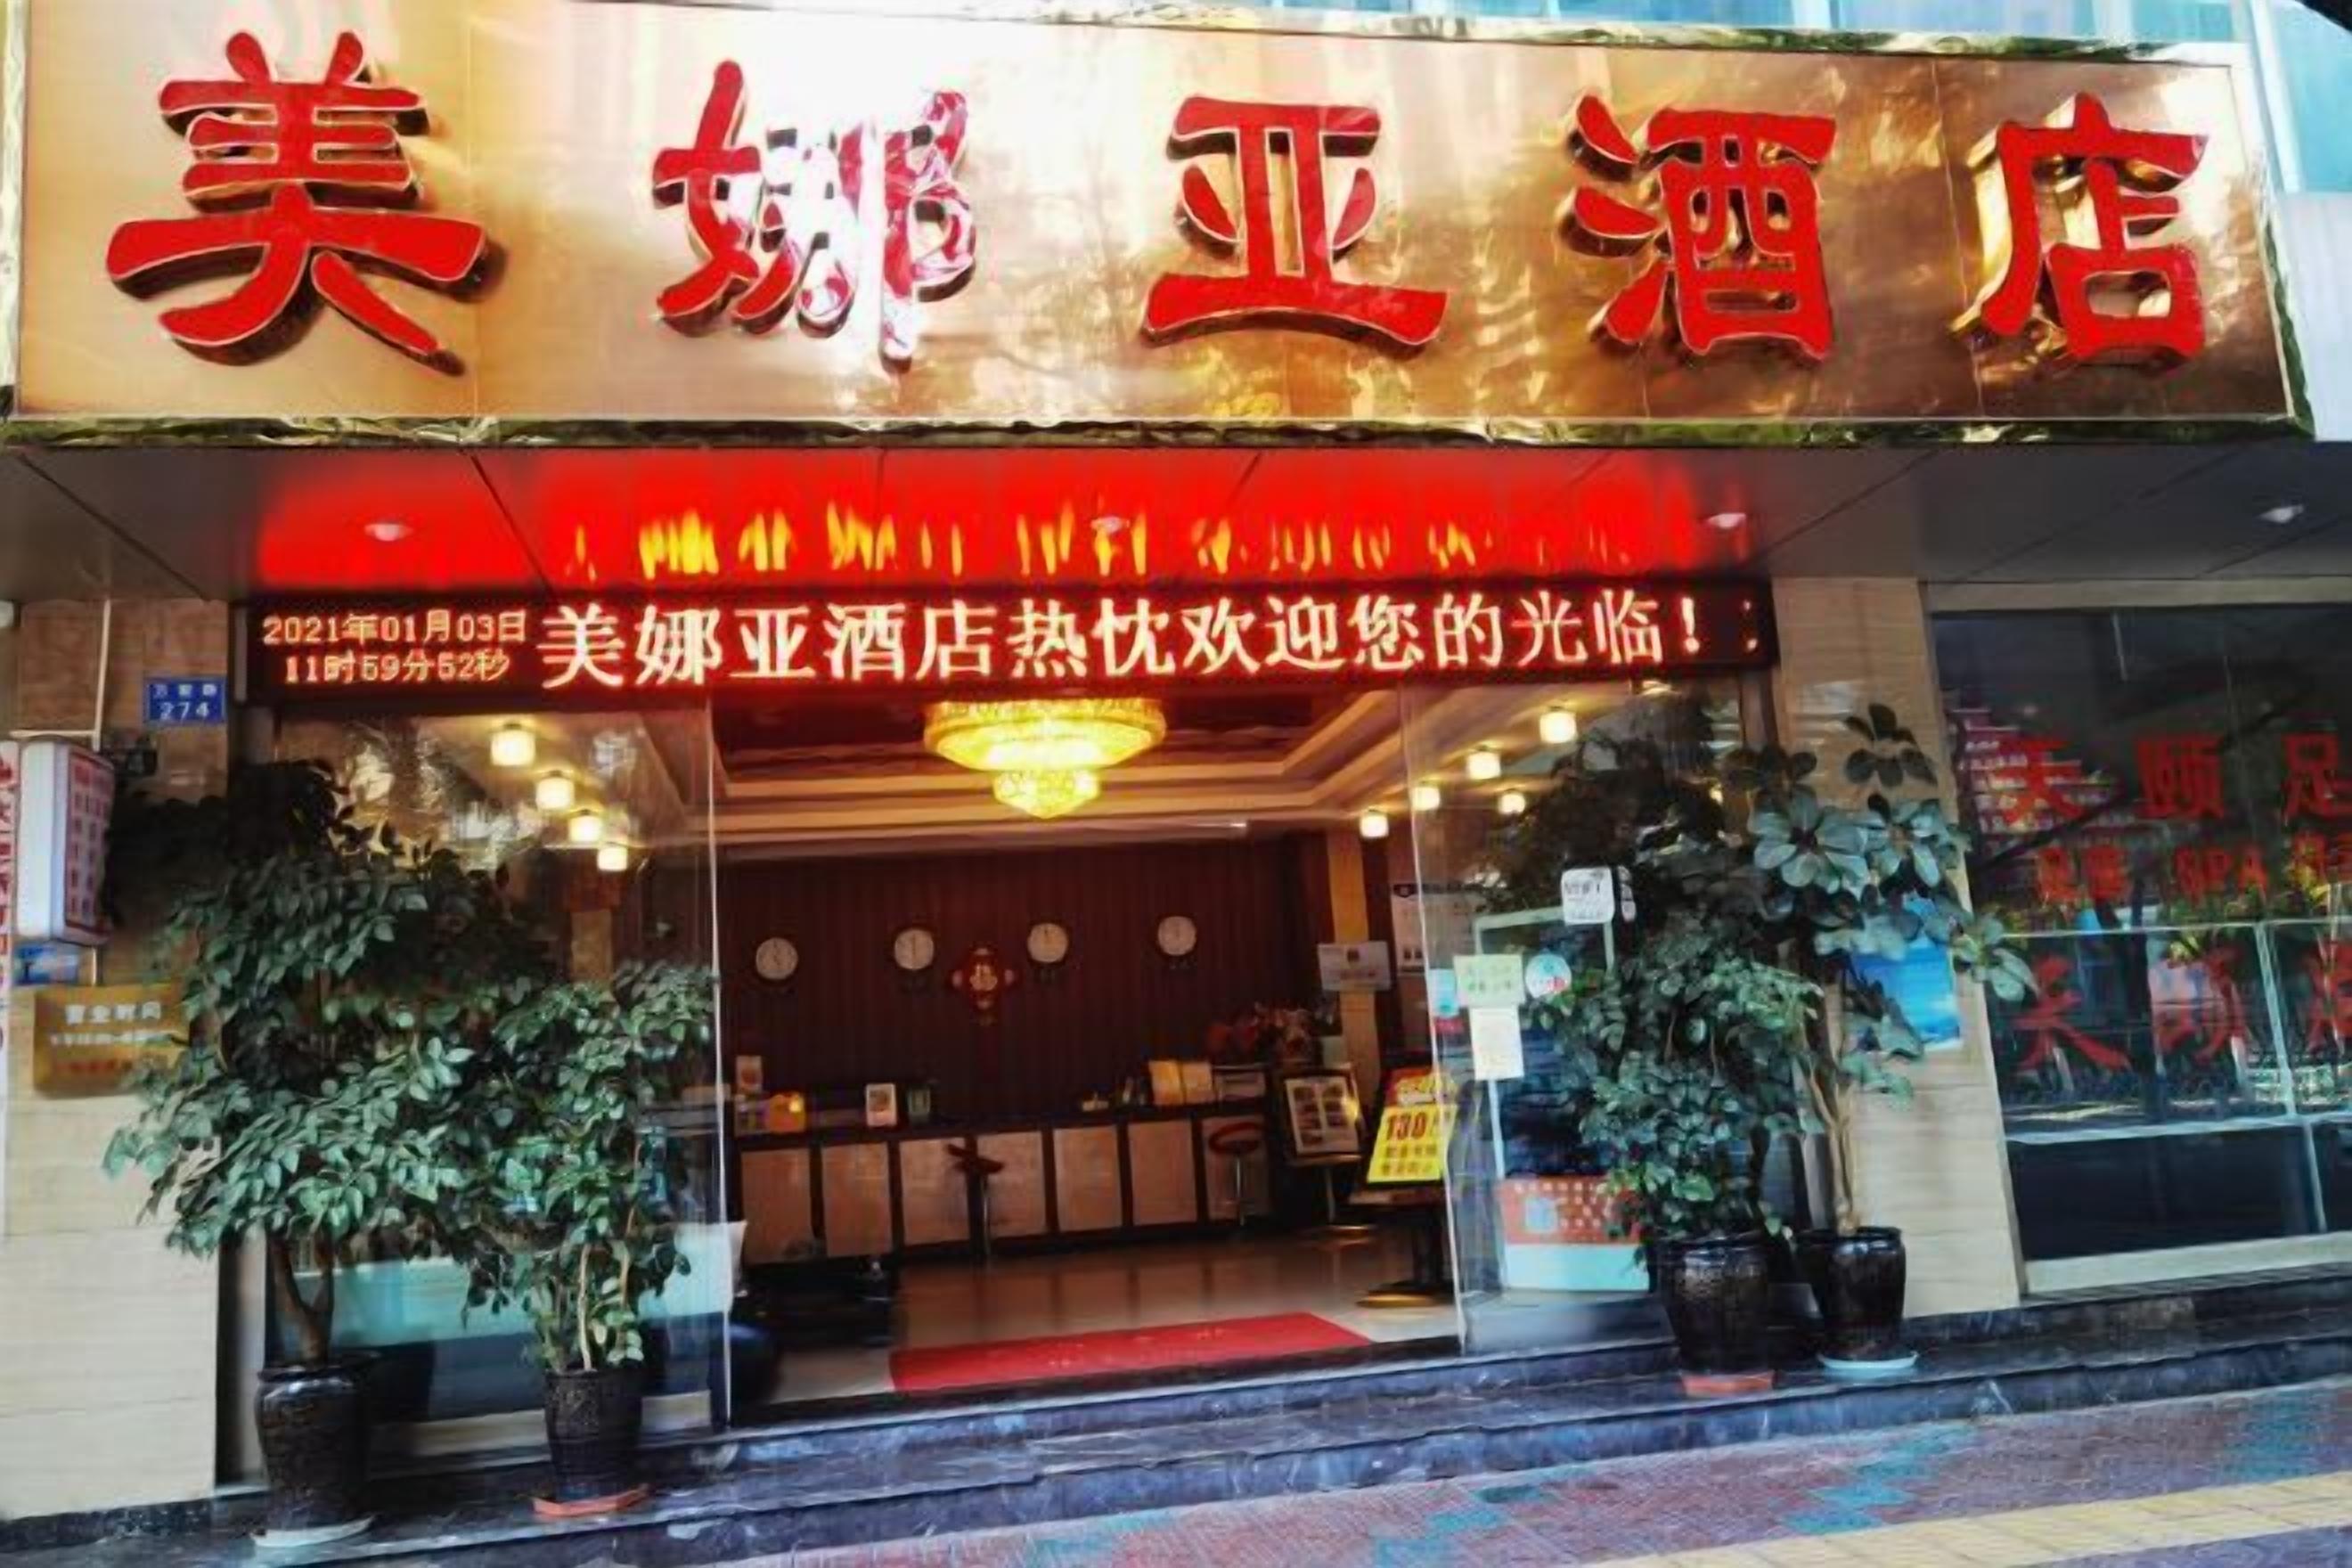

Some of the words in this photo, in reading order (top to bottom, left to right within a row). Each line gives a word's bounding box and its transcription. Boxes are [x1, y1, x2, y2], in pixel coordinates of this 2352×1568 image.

[105, 30, 2208, 376] 美娜亚酒店
[262, 608, 527, 646] 2021年01月03日
[284, 648, 511, 684] 11时59分52秒
